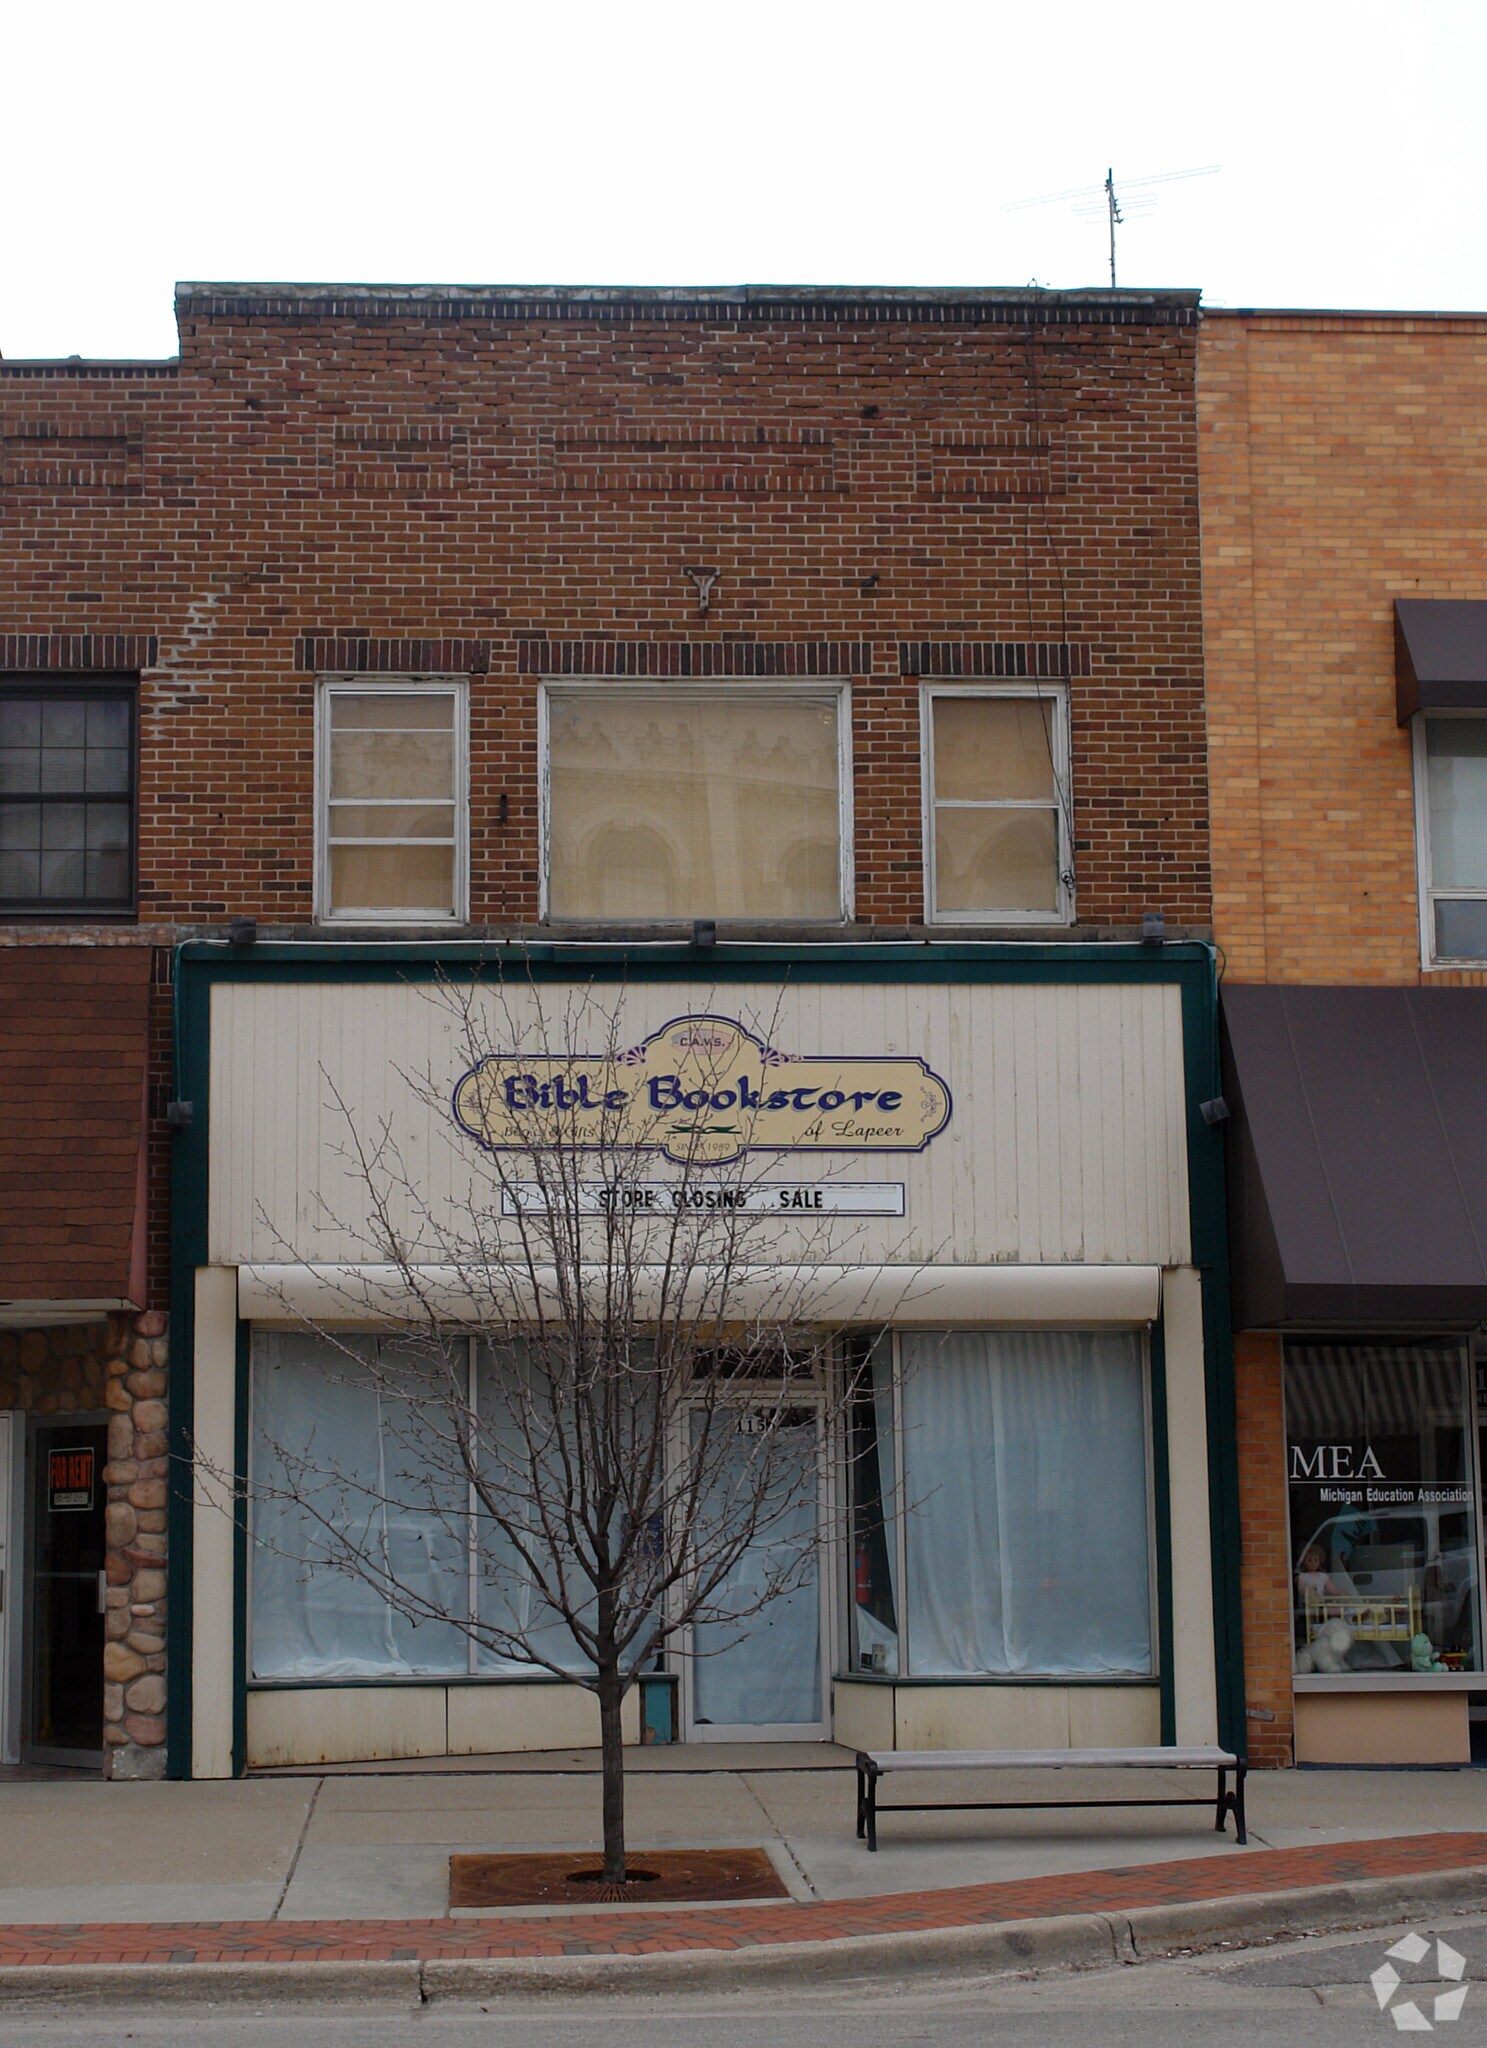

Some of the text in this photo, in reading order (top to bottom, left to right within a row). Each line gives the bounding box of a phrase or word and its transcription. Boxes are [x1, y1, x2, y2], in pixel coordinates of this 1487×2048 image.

[503, 1074, 903, 1113] Bible Bookstore
[804, 1120, 905, 1142] of Lapeer
[675, 1142, 731, 1153] SIN 1989
[599, 1190, 823, 1208] STORE CLOSING SALE
[50, 1455, 92, 1489] FOR RENT
[1289, 1445, 1387, 1479] MEA
[1320, 1488, 1474, 1504] Michigan Education Association
